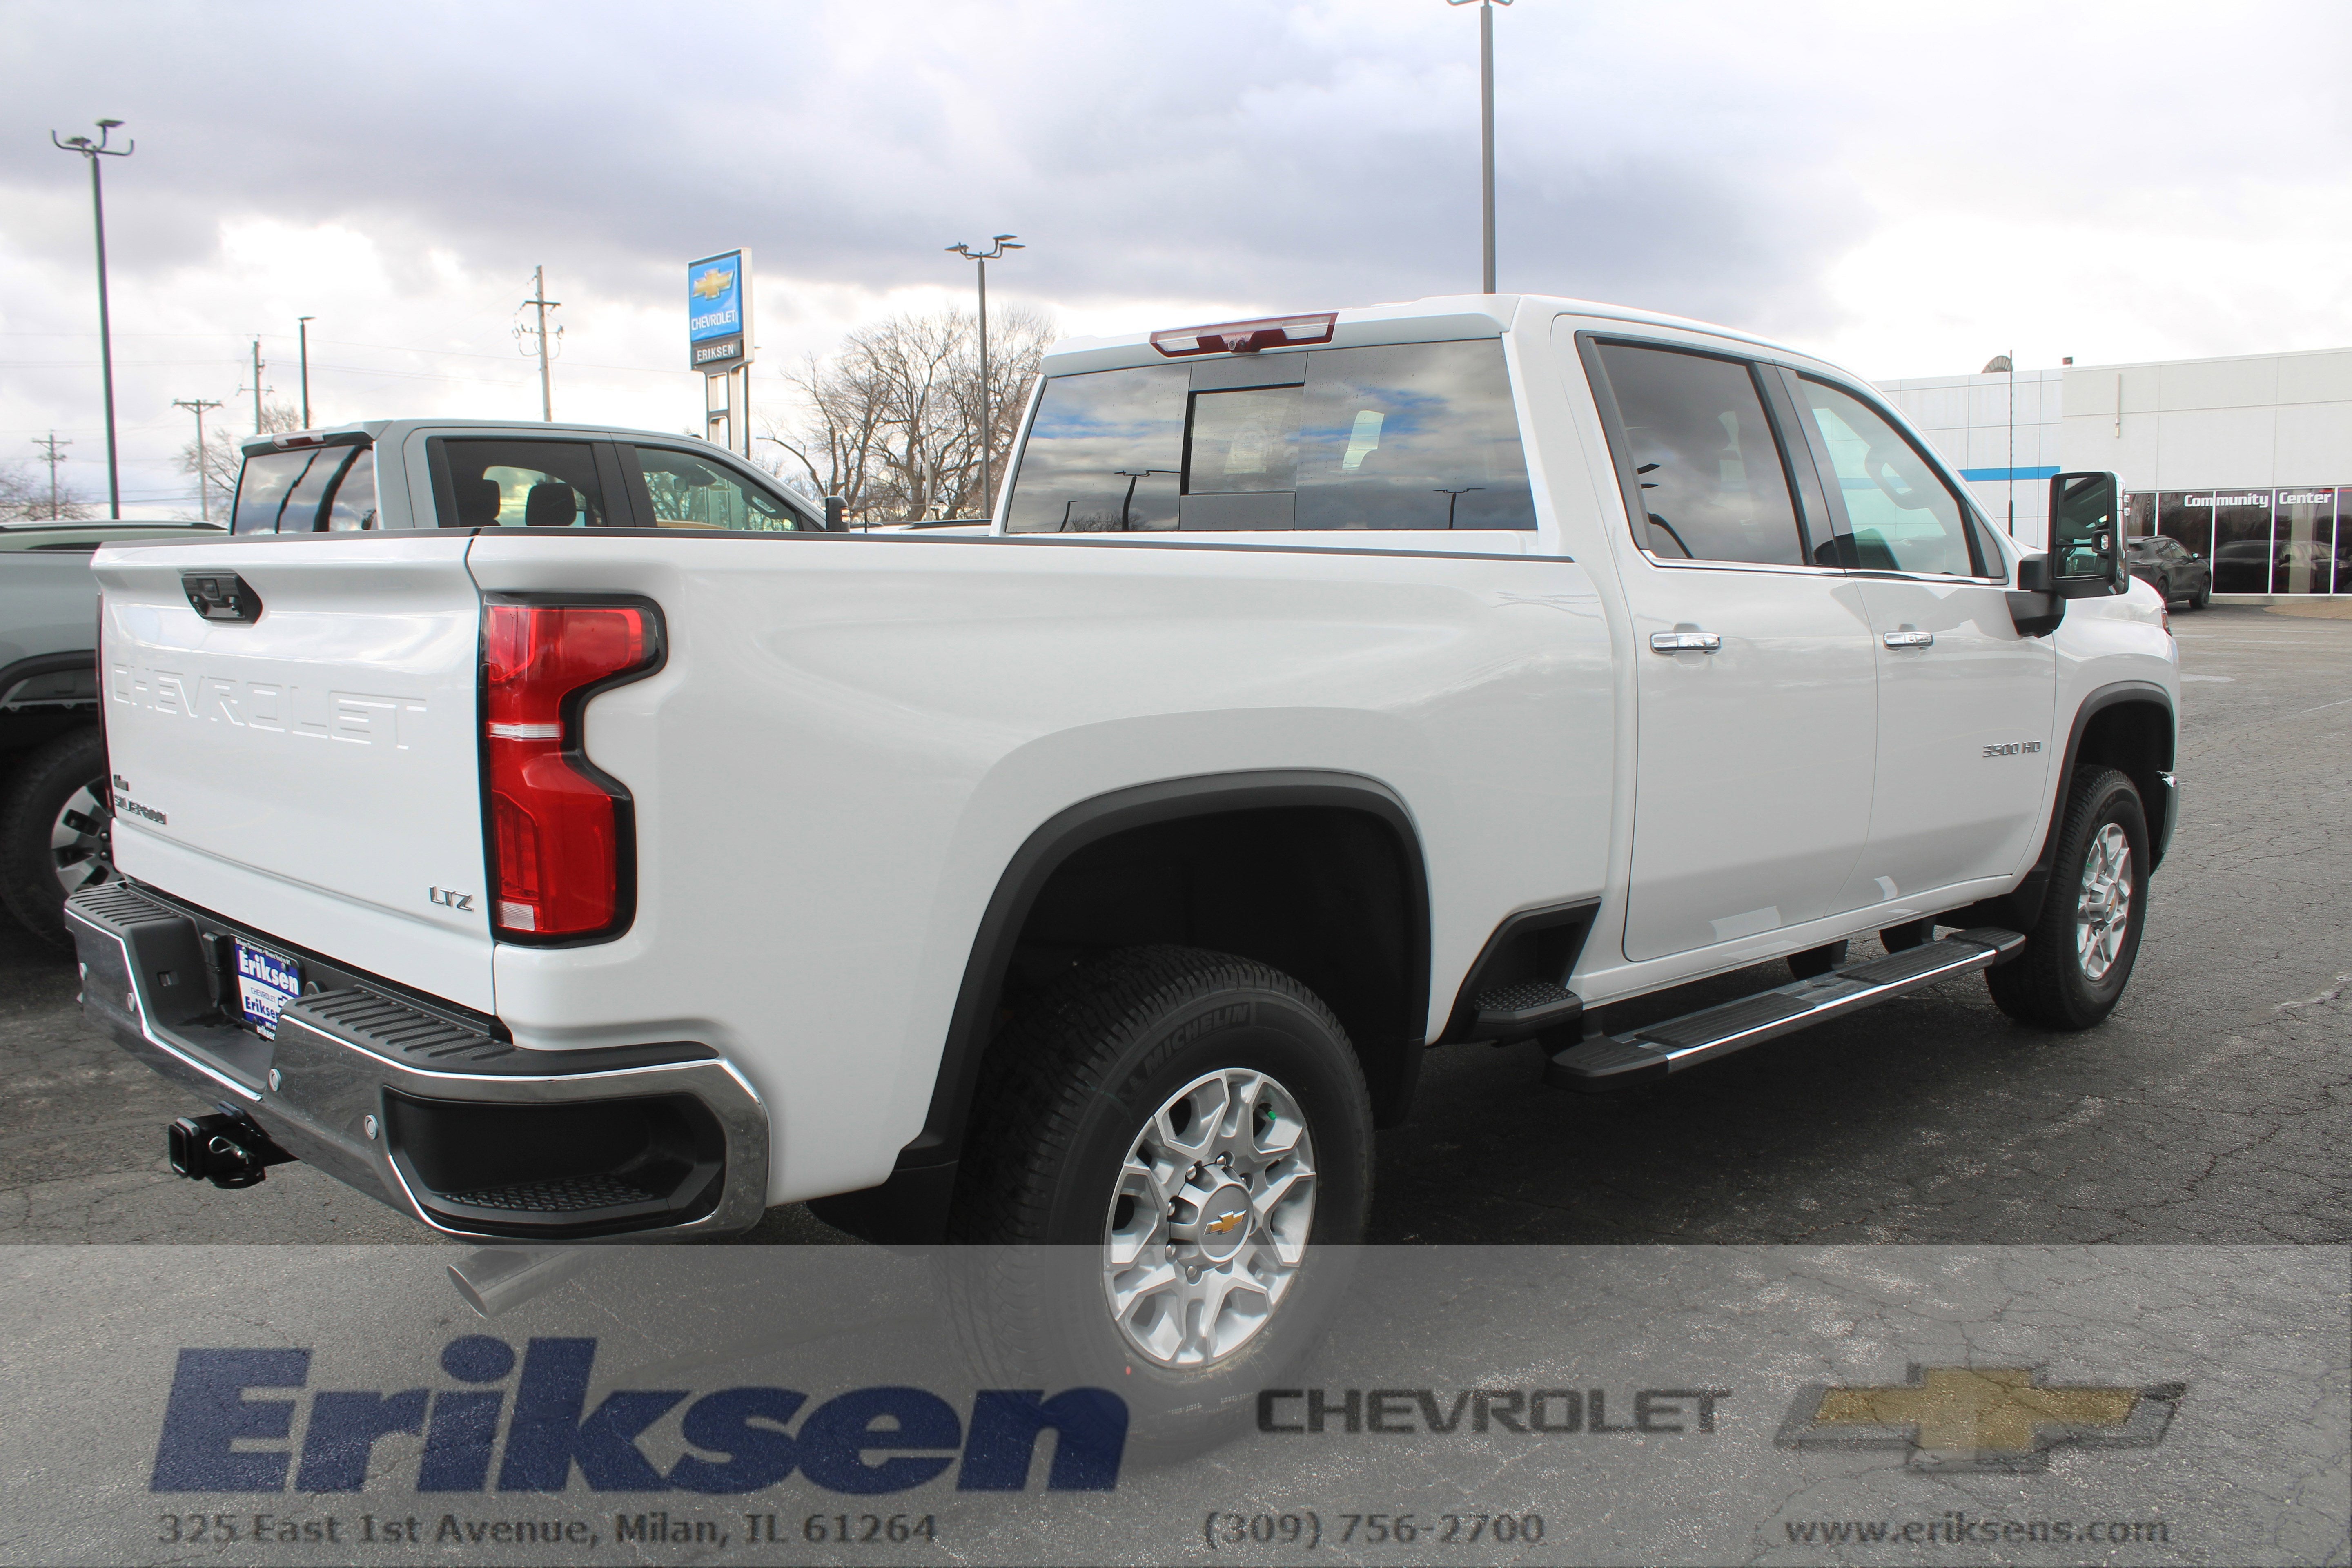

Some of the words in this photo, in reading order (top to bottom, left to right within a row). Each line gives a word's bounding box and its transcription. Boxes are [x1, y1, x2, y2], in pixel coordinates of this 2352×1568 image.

[691, 310, 736, 330] CHEVROLET
[697, 344, 734, 361] ERIKSEN
[2184, 493, 2269, 508] Community
[2278, 492, 2332, 505] Center
[113, 663, 427, 751] CHEVROLET
[1982, 742, 2019, 758] 3500
[2022, 740, 2041, 754] HD
[429, 885, 474, 912] LTZ
[238, 949, 299, 996] Eriksen
[250, 987, 276, 1003] CHEVROLET
[1143, 1004, 1249, 1078] MICHELIN
